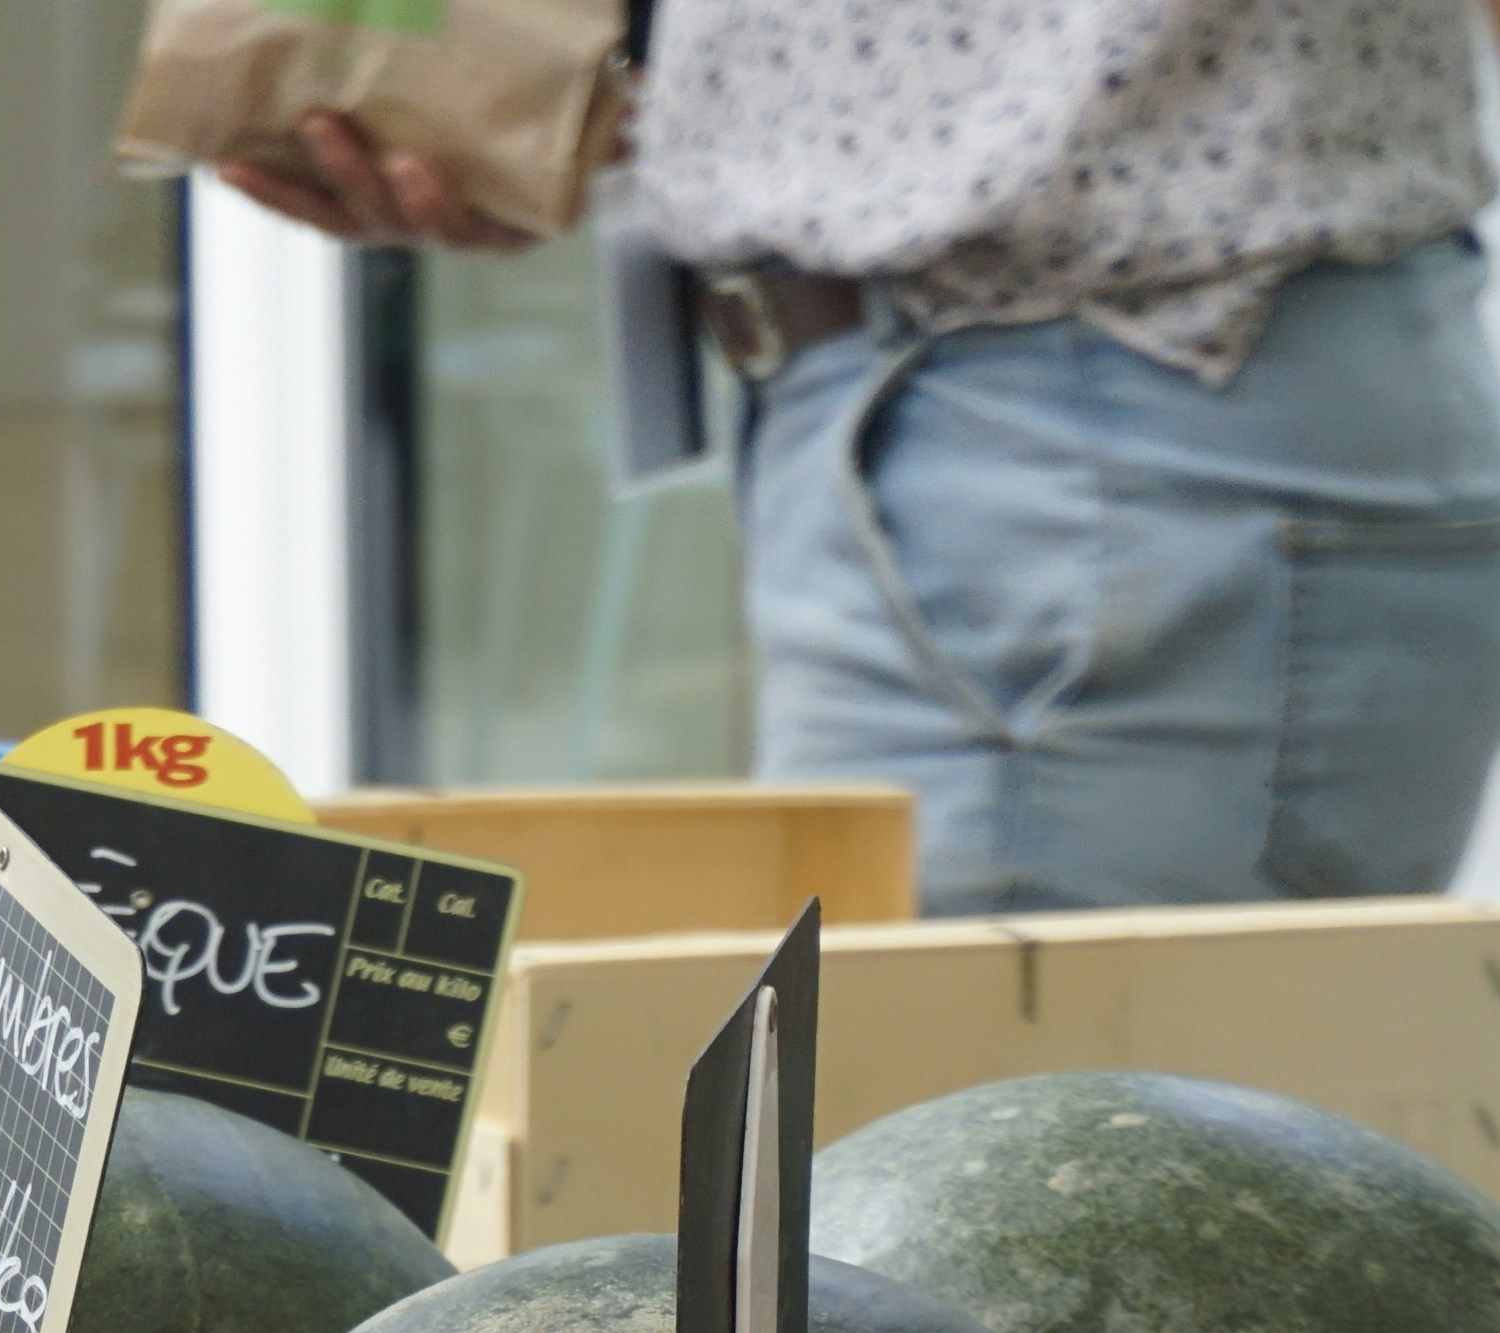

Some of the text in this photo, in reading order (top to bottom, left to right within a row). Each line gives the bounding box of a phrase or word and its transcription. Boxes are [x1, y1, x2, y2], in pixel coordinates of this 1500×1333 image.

[73, 721, 212, 788] 1kg
[346, 957, 483, 1002] Prix au kilo
[447, 1024, 474, 1049] €
[324, 1055, 465, 1102] Unité de vente
